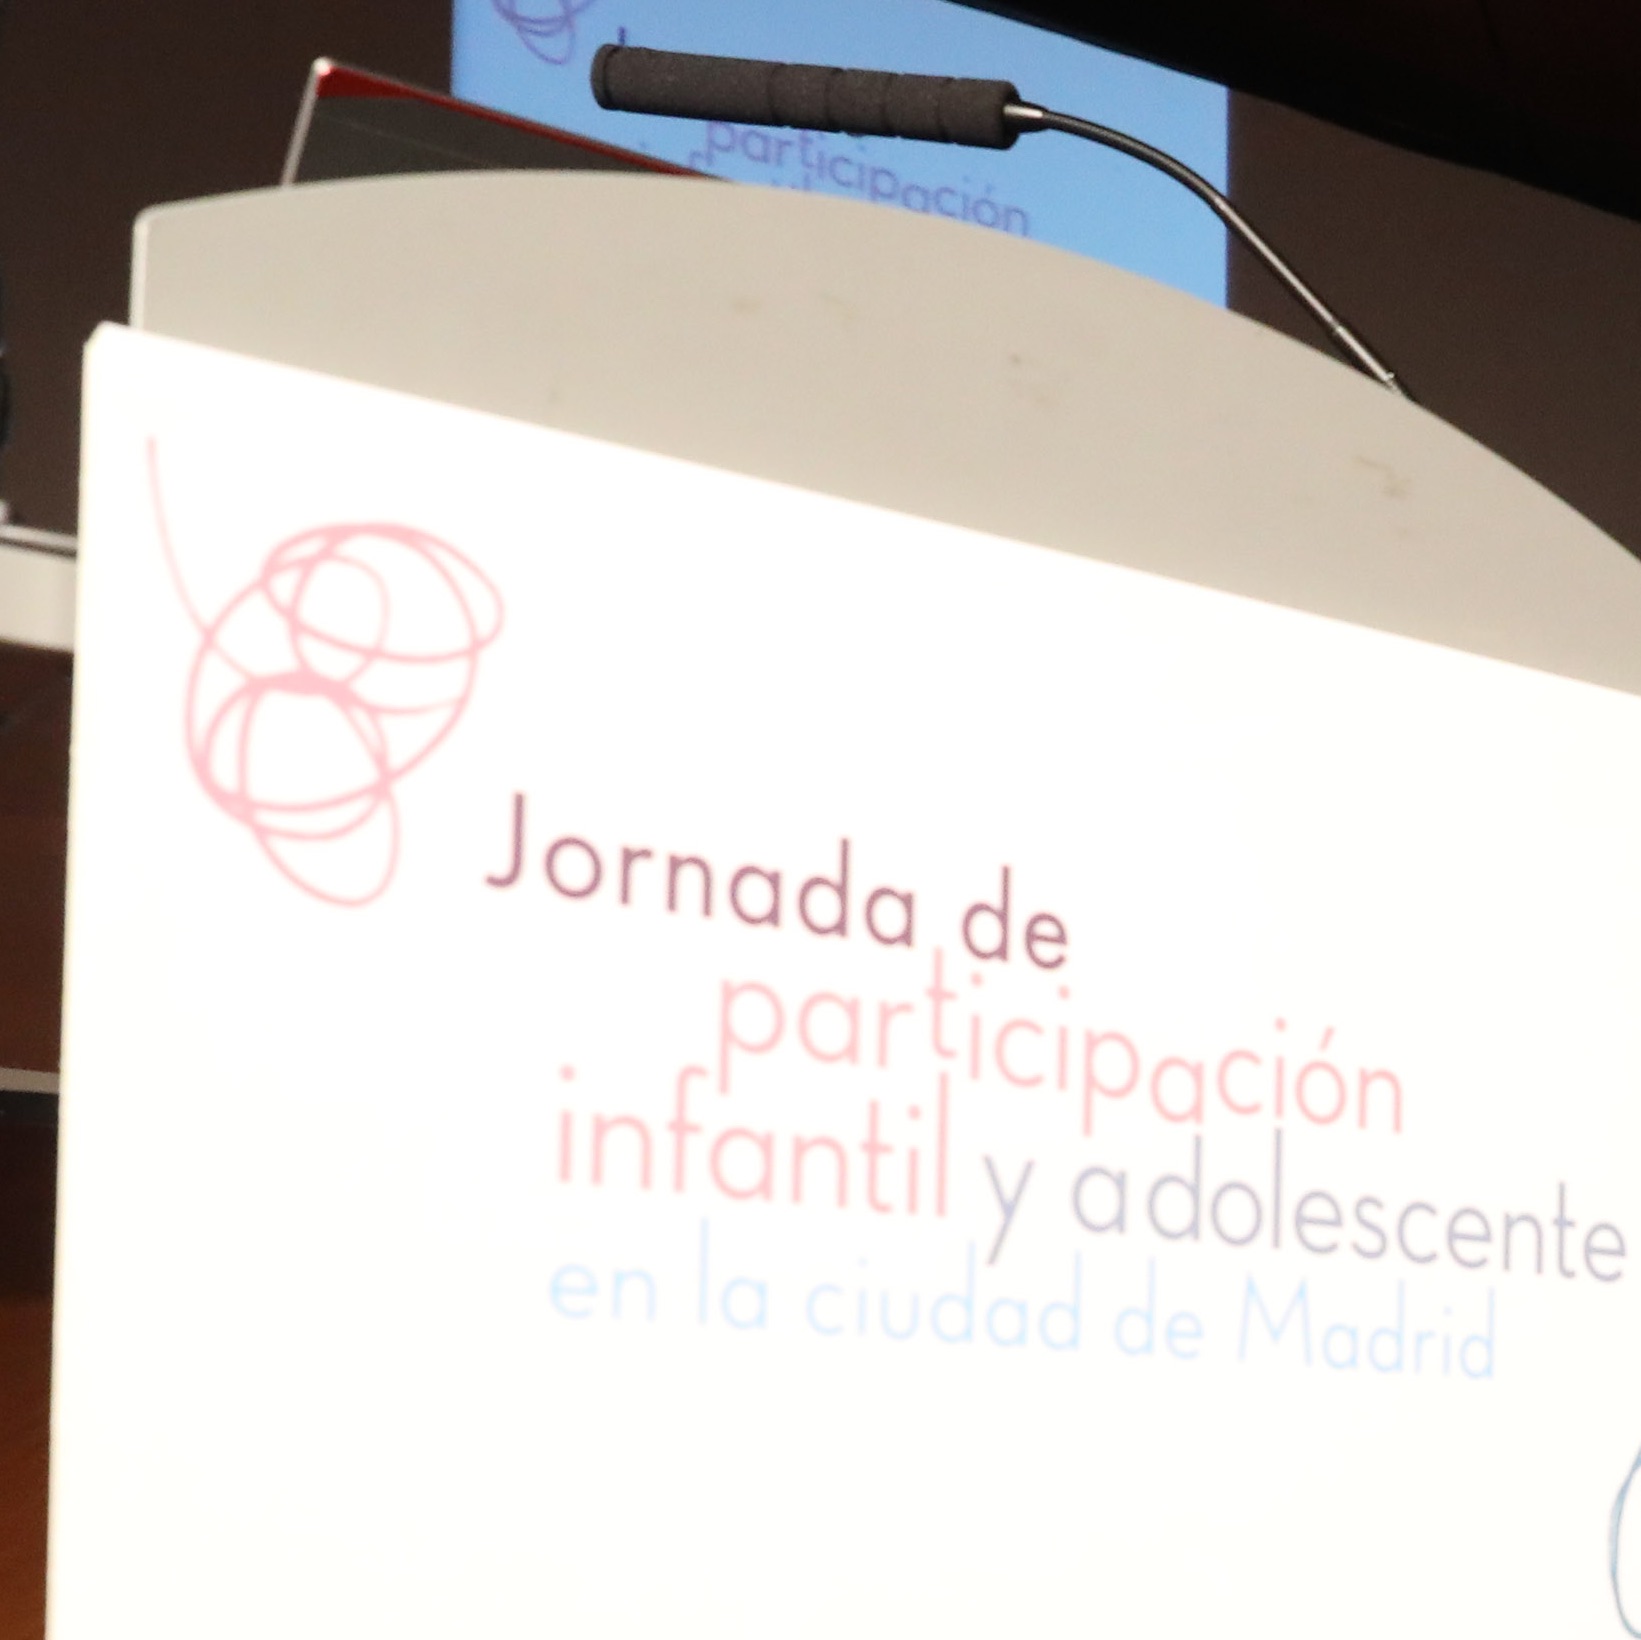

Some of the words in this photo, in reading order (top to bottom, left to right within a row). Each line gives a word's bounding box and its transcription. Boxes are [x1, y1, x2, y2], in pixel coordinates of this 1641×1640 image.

[481, 789, 918, 951] Jornada
[959, 863, 1071, 974] de
[717, 945, 1403, 1138] participación
[556, 1064, 952, 1218] infantil
[982, 1154, 1035, 1267] y
[1071, 1127, 1627, 1284] adolescente
[548, 1262, 657, 1319] en
[697, 1218, 769, 1330] la
[805, 1243, 1082, 1352] ciudad
[1113, 1261, 1205, 1361] de
[1236, 1276, 1497, 1381] Madrid
